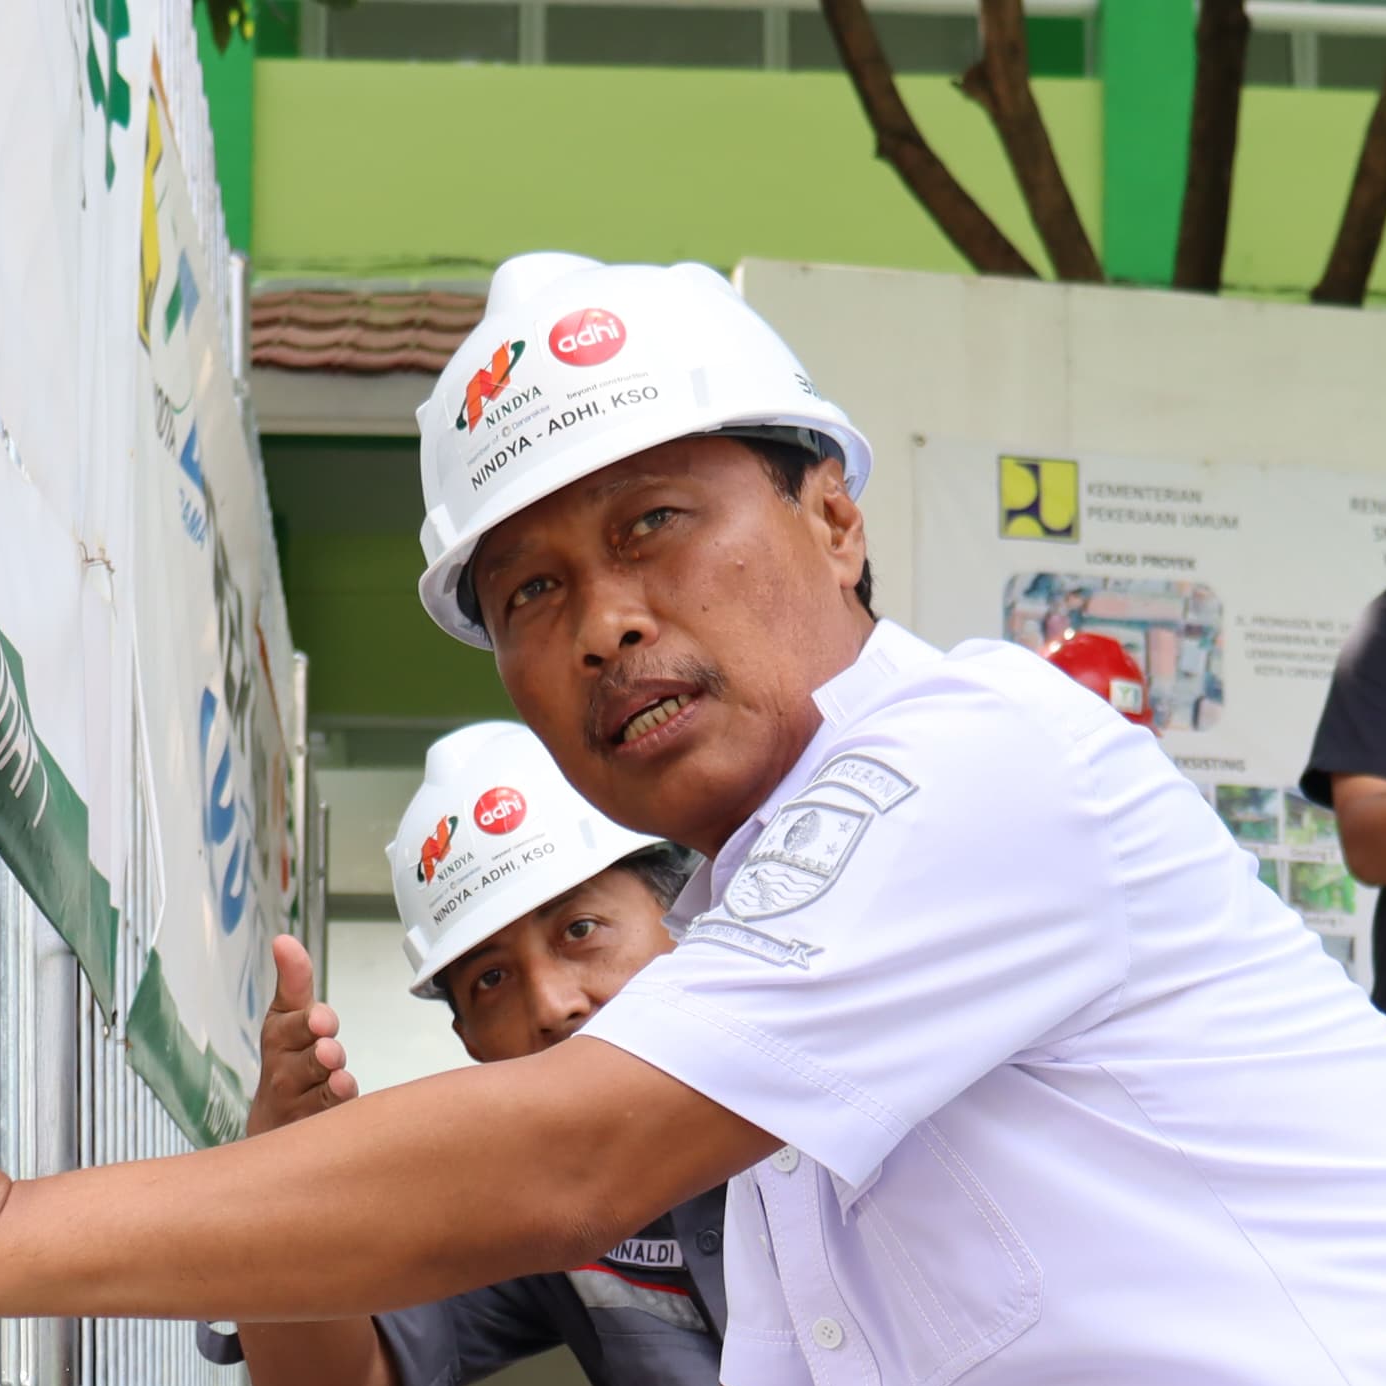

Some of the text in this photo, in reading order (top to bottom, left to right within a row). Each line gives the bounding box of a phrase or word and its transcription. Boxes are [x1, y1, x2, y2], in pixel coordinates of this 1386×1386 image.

[557, 319, 620, 353] adhi
[485, 385, 543, 429] NINDYA
[470, 435, 533, 492] NINDYA
[548, 400, 606, 436] ADHI,
[611, 386, 659, 409] KSO
[1087, 483, 1203, 504] KEMENTERIAN
[480, 794, 523, 826] adhi
[432, 888, 473, 926] NINDYA
[521, 842, 556, 864] KSO
[437, 851, 475, 884] NINDYA
